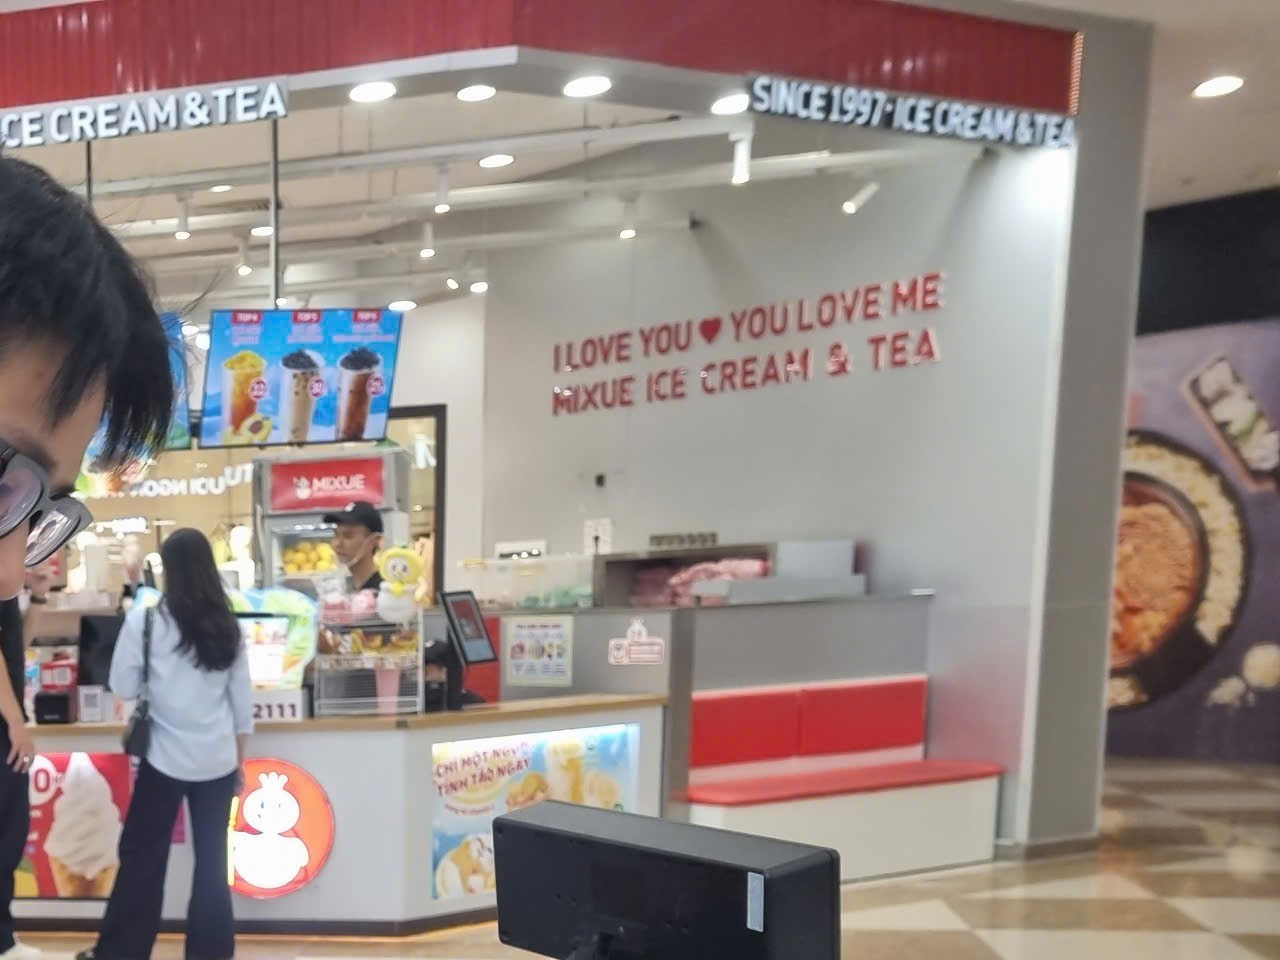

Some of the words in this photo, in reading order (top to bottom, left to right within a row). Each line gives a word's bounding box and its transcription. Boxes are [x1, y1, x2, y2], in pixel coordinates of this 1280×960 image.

[753, 75, 827, 120] SINCE
[639, 319, 693, 358] YOU
[729, 304, 789, 343] YOU
[797, 283, 882, 333] LOVE
[890, 272, 941, 317] ME
[552, 375, 635, 417] MIXUE
[646, 367, 688, 403] ICE
[700, 347, 811, 395] CREAM
[867, 328, 939, 372] TEA
